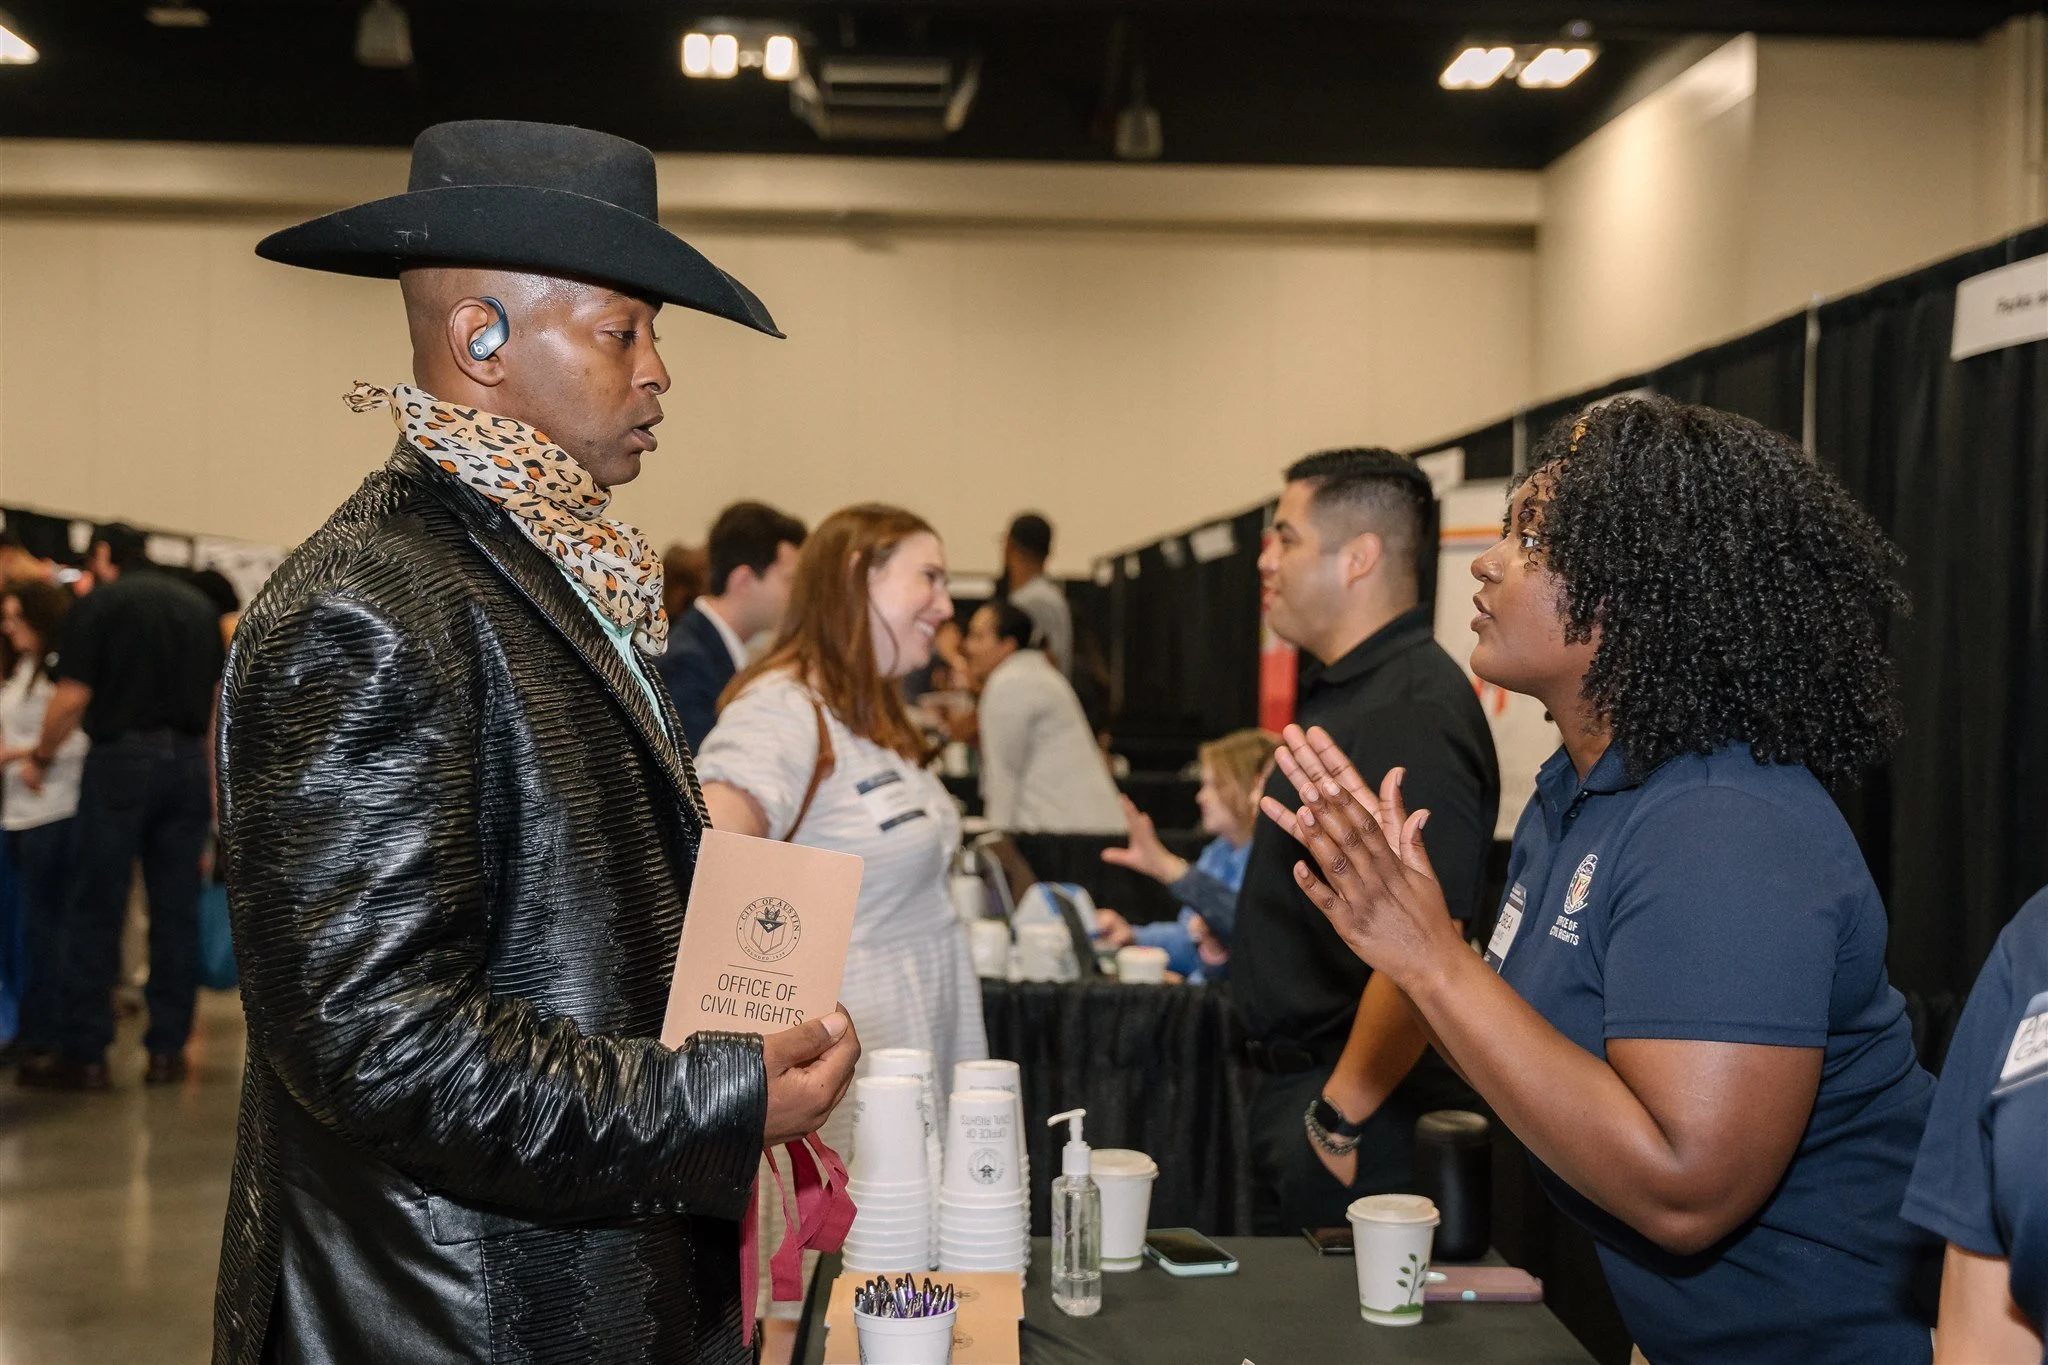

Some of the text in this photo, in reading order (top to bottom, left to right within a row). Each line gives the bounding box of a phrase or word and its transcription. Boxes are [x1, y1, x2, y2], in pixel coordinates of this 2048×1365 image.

[741, 902, 757, 921] CITY
[777, 901, 801, 931] AUSTIN
[1568, 920, 1578, 931] OF
[717, 973, 798, 1002] OFFICE OF
[700, 994, 804, 1027] CIVIL RIGHTS
